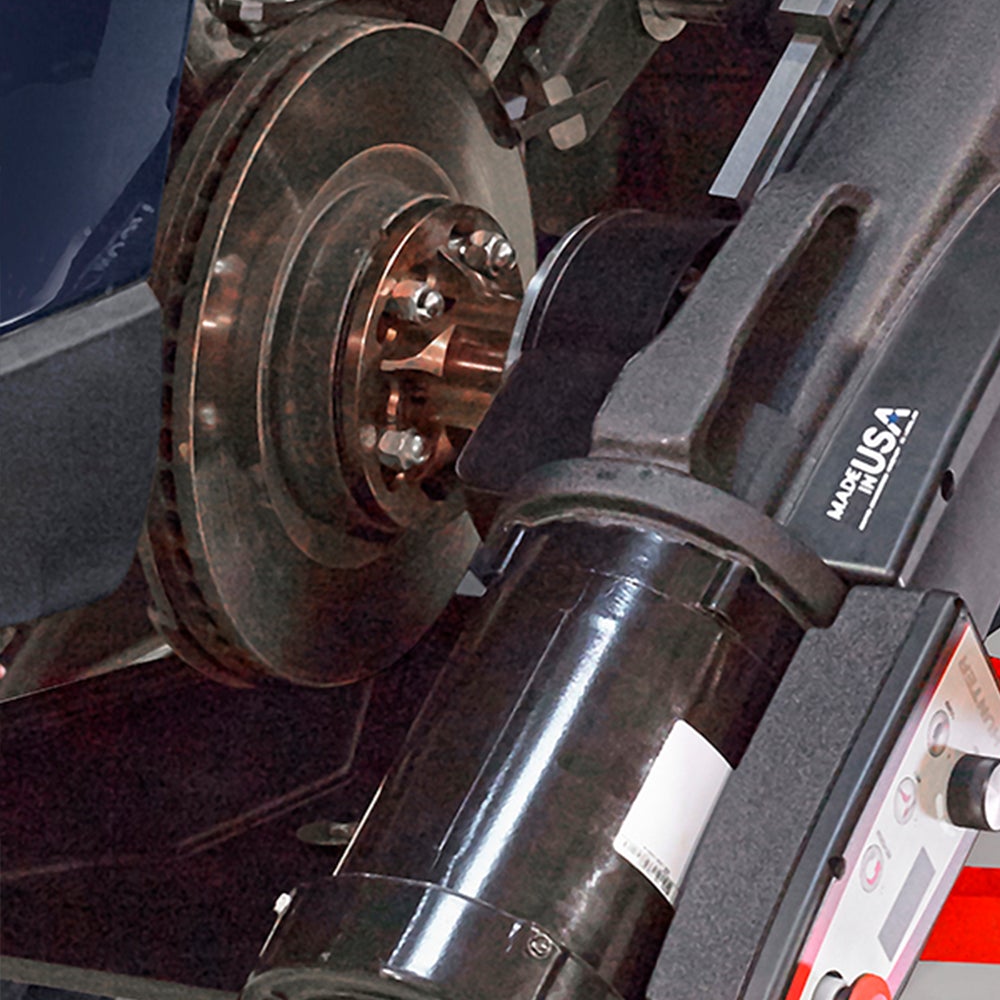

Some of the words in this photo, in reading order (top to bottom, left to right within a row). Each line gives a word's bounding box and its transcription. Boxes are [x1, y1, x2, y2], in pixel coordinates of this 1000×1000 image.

[850, 407, 912, 475] USA
[826, 467, 862, 521] MADE
[858, 473, 879, 495] IN
